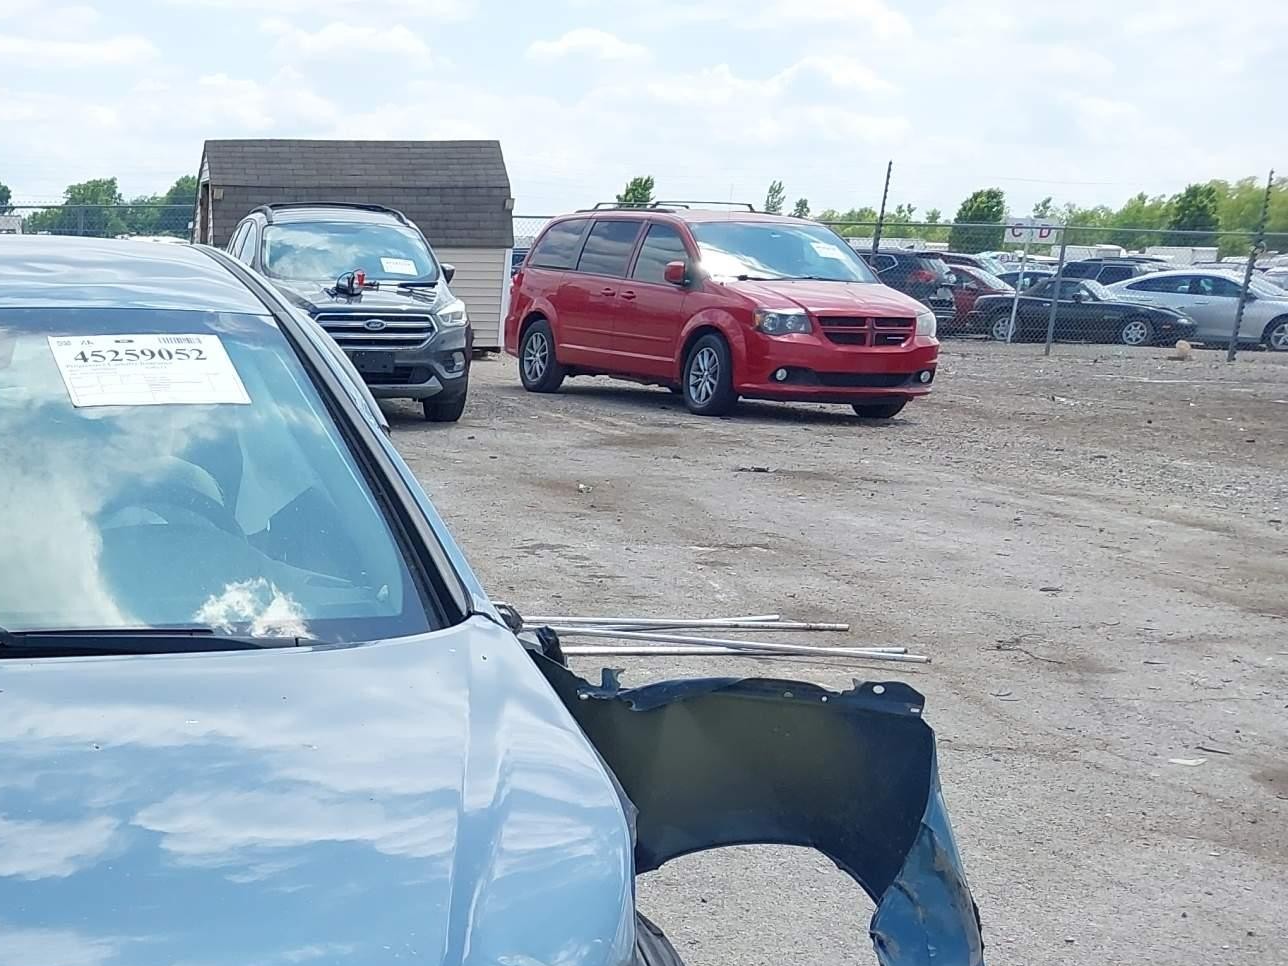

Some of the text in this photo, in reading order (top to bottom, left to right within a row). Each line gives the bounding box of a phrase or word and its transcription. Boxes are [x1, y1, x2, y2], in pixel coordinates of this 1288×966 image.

[1012, 223, 1052, 238] C D
[74, 348, 207, 363] 45259052
